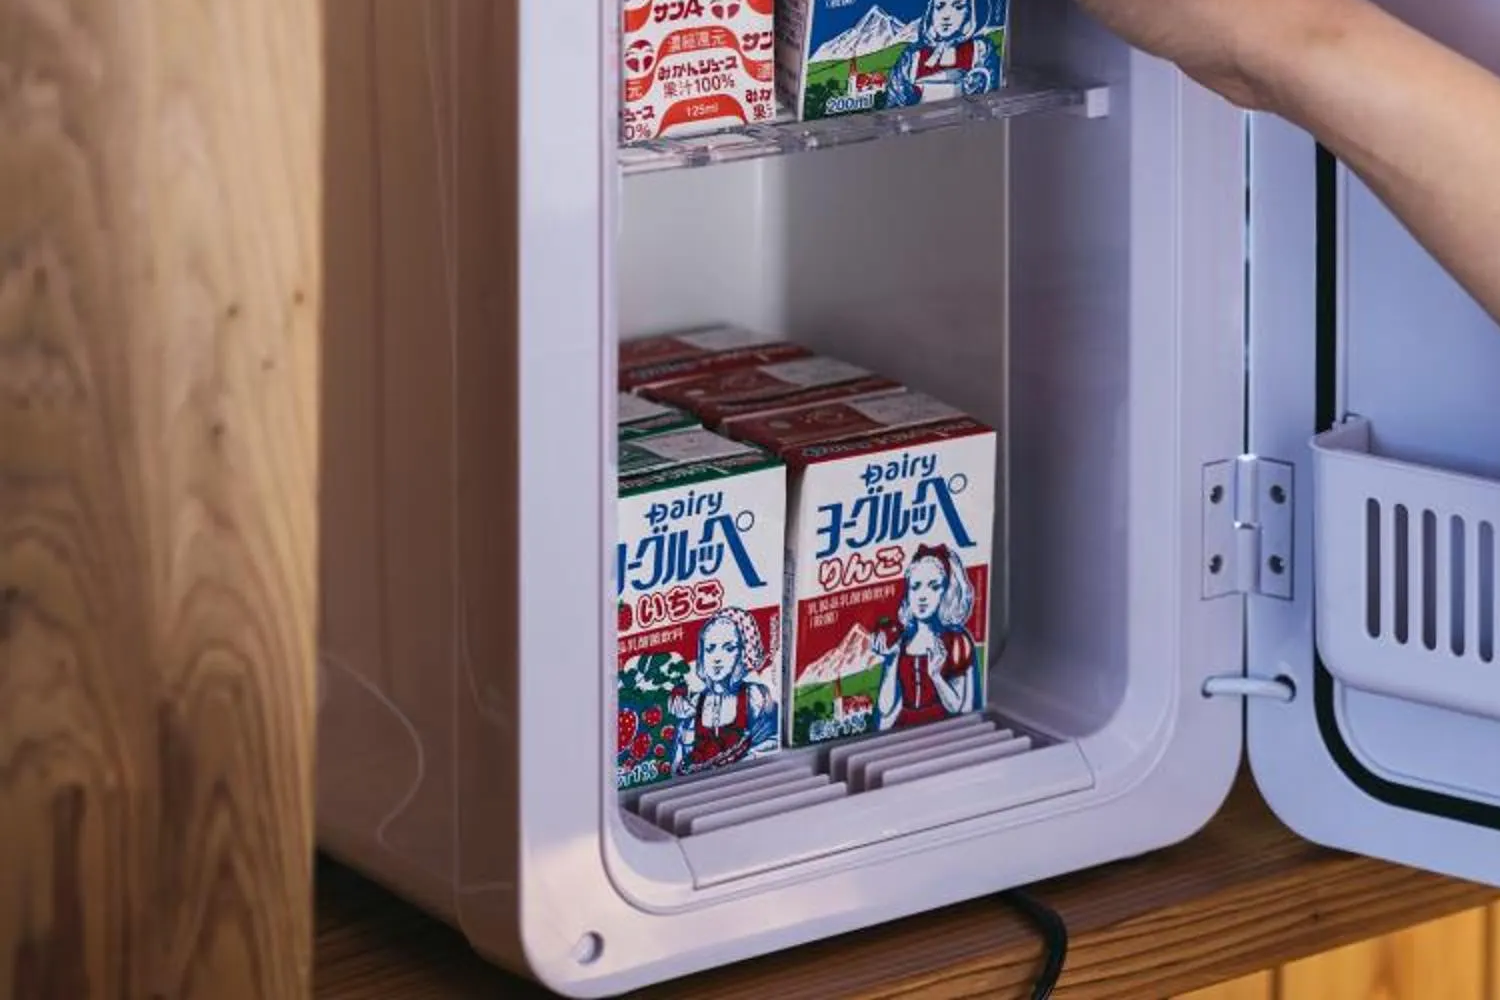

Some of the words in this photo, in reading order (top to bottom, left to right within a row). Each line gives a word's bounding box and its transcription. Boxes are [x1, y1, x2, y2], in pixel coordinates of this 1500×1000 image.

[658, 56, 738, 81] みかんジュース
[663, 74, 735, 98] 果汁100%
[686, 103, 719, 117] 125ml
[860, 453, 937, 488] Dairy
[644, 490, 723, 526] Dairy
[816, 473, 977, 559] ヨーグルッペ
[818, 546, 905, 592] りんご
[637, 579, 724, 628] いちご
